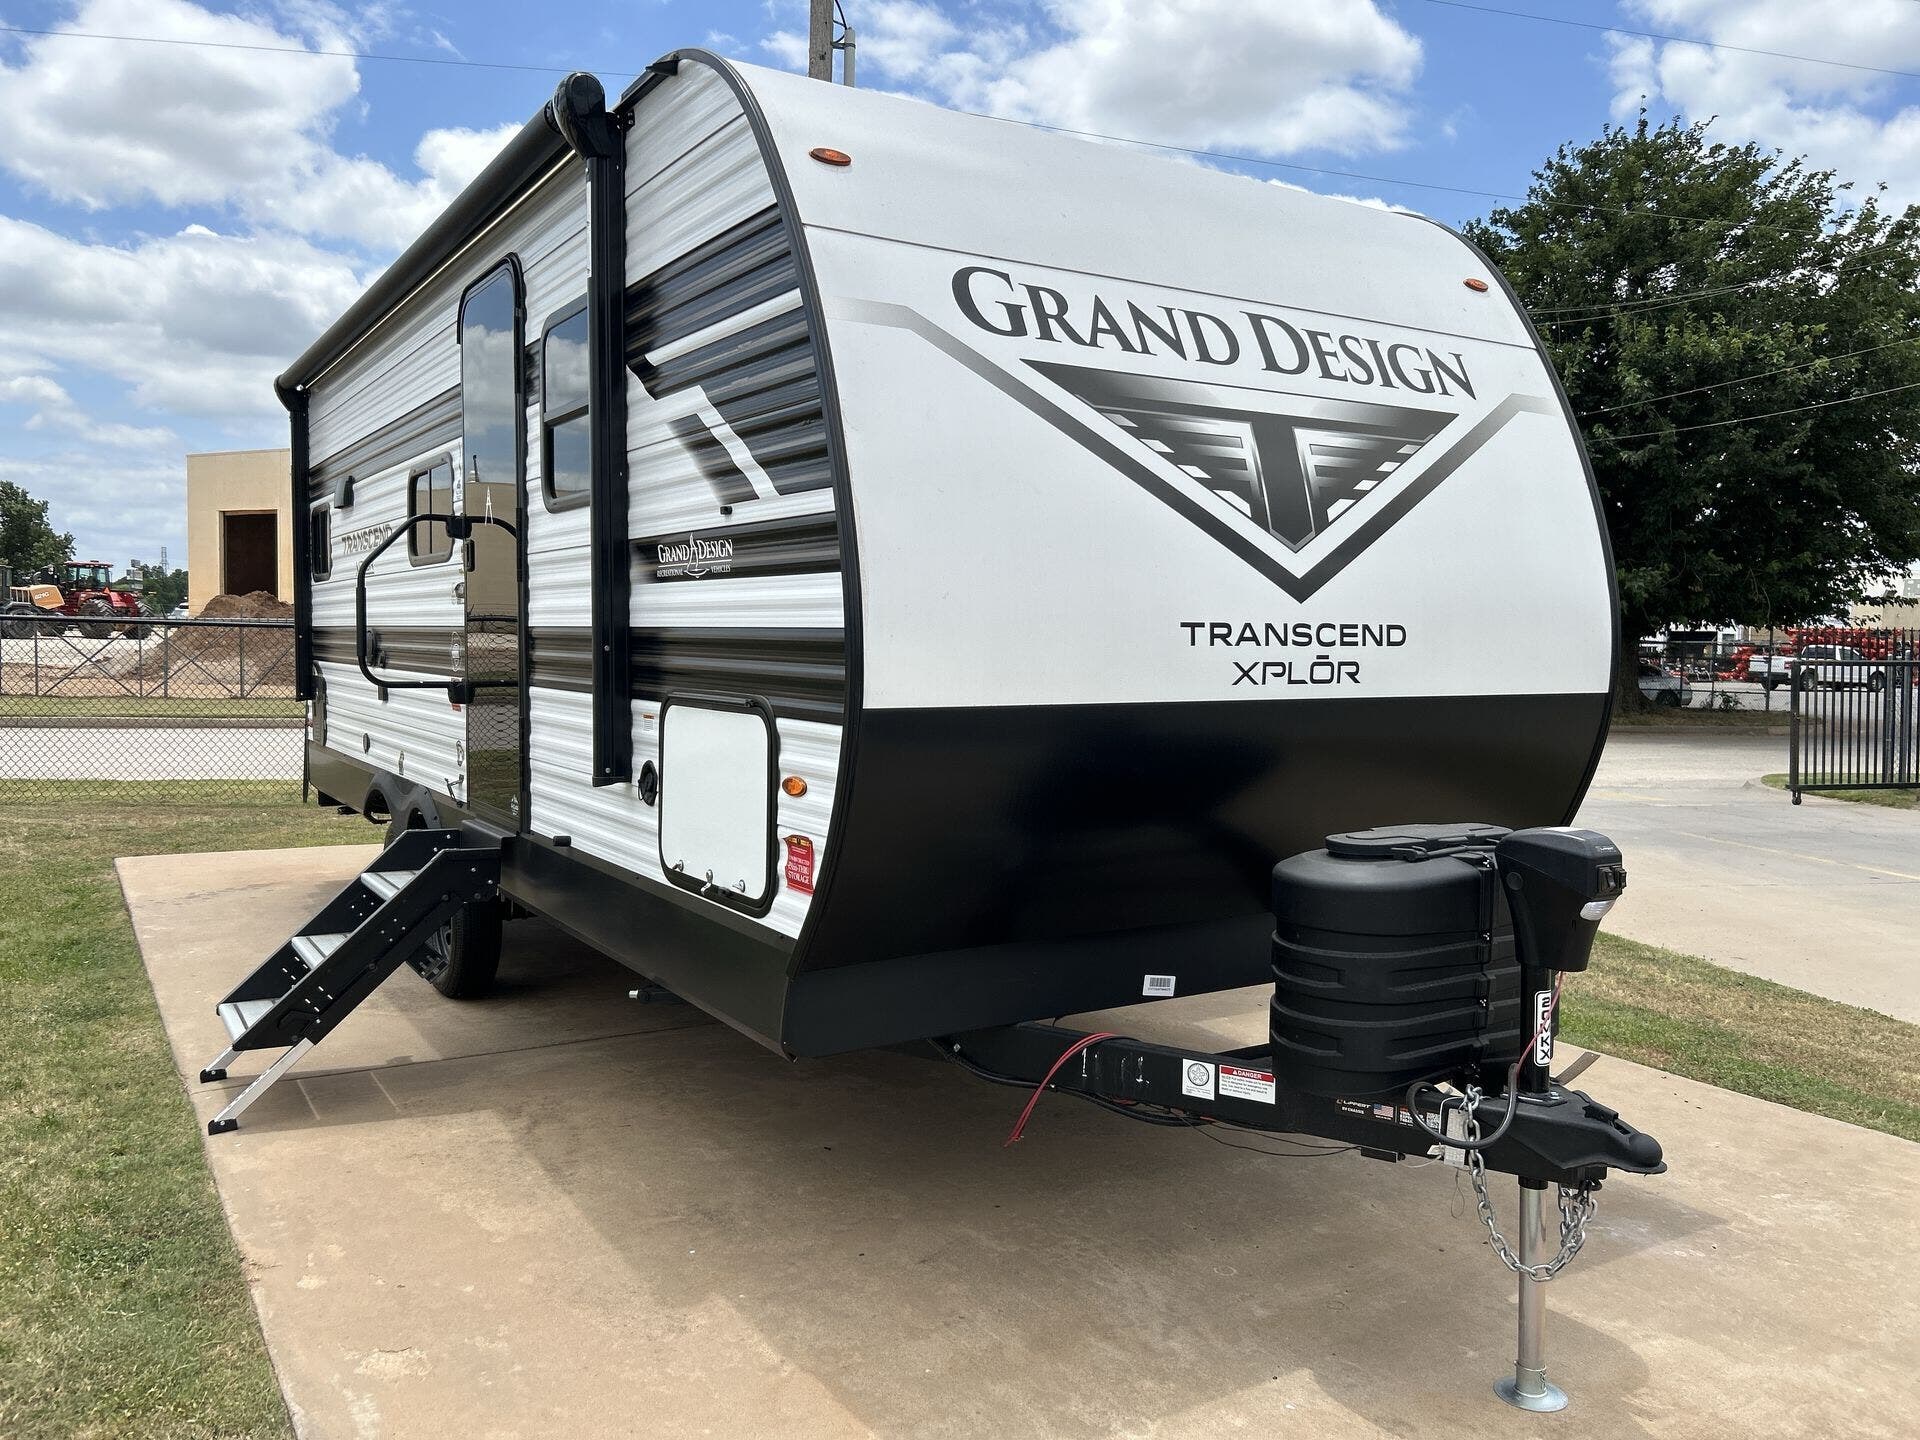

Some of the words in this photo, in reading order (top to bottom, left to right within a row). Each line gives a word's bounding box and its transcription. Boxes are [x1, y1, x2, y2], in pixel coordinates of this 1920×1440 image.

[951, 266, 1240, 366] GRAND
[1239, 310, 1477, 400] DESIGN
[657, 544, 690, 563] GRAND
[696, 539, 733, 560] DESIGN
[710, 565, 731, 574] VEHICLES
[1180, 621, 1407, 647] TRANSCEND
[1237, 1070, 1262, 1080] DANGER
